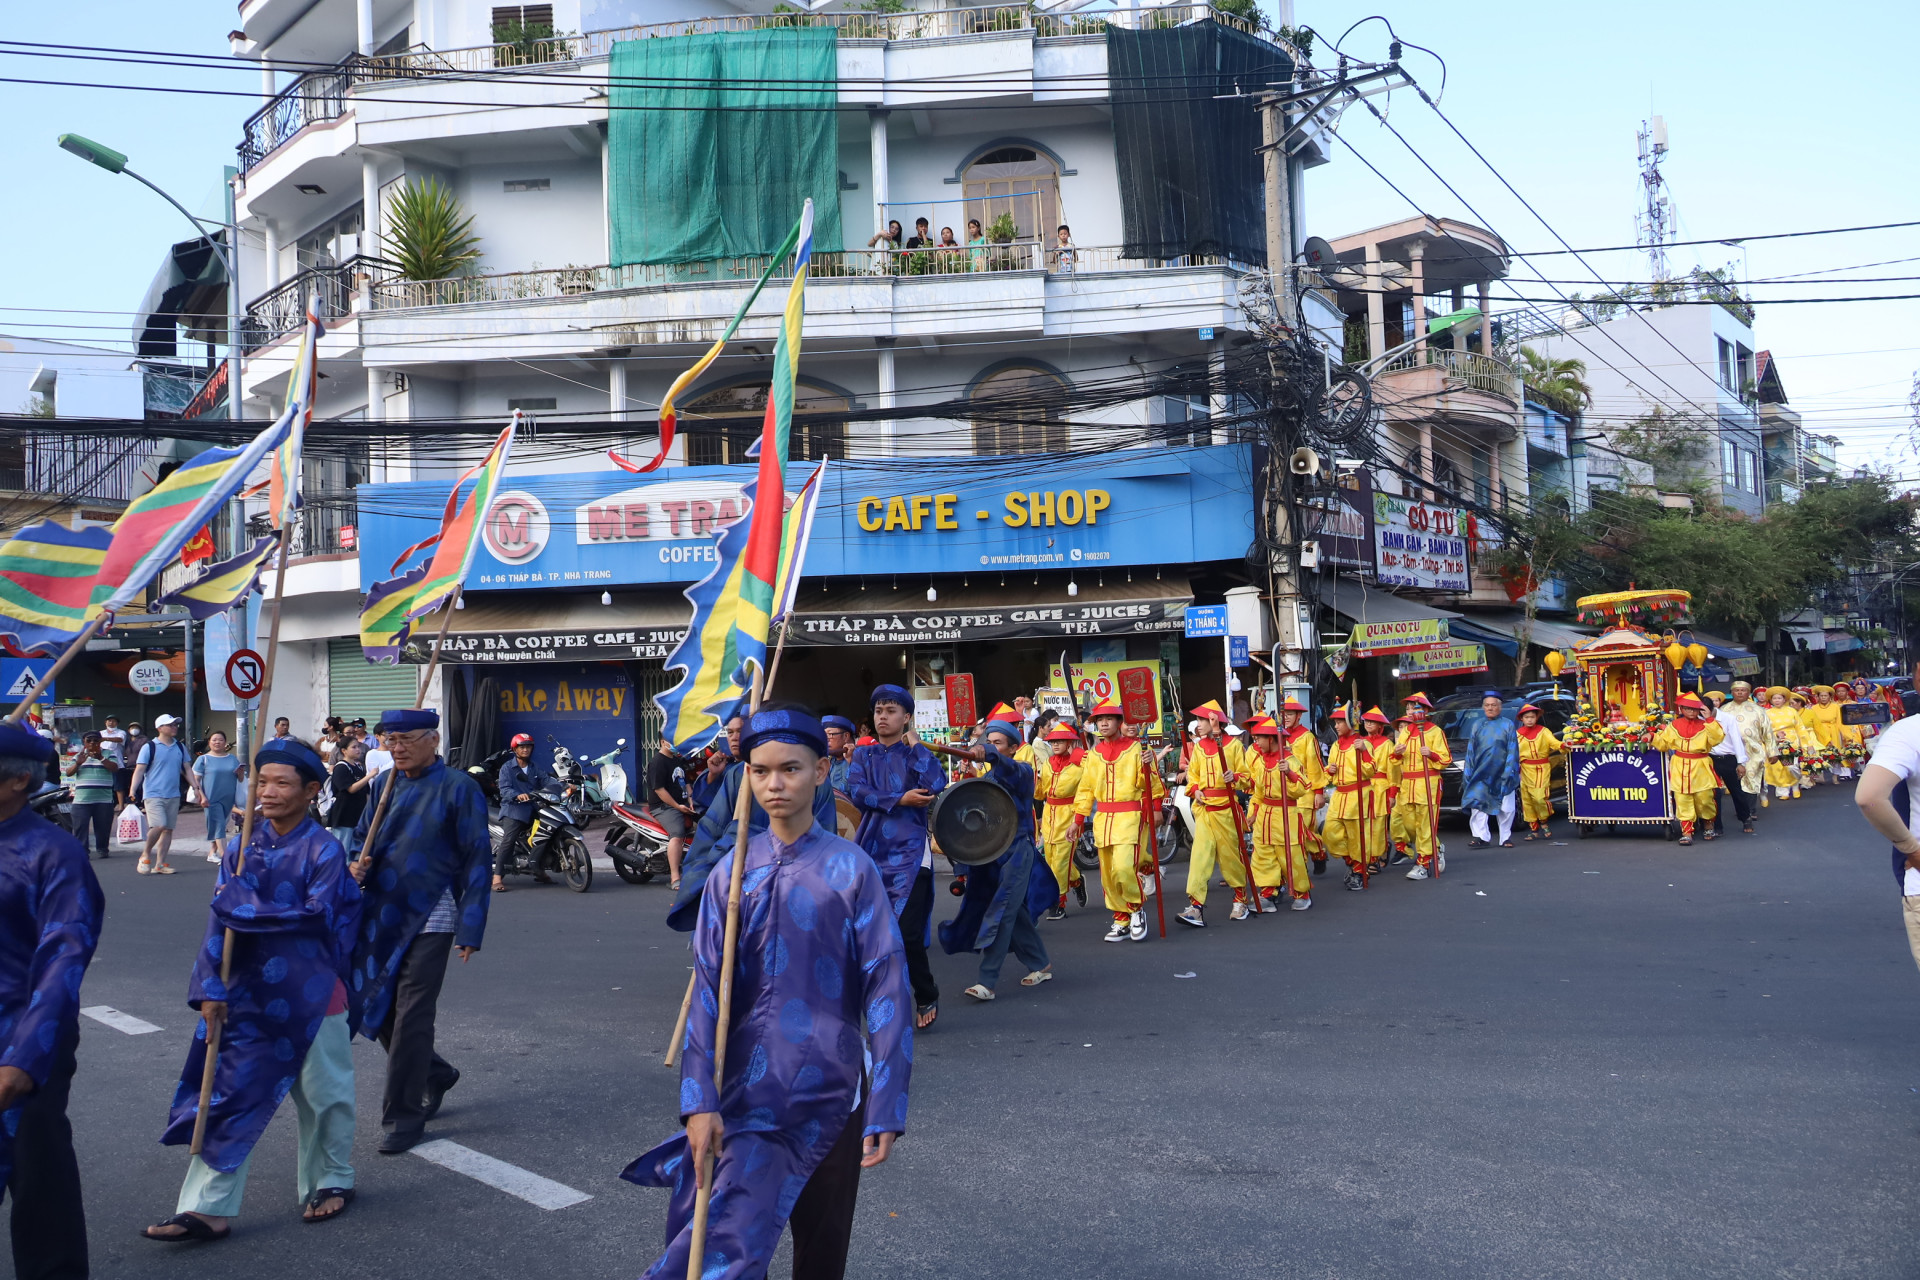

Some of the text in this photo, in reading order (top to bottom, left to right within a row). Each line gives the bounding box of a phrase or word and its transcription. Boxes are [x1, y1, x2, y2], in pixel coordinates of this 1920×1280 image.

[856, 493, 959, 532] CAFE
[1002, 489, 1111, 528] SHOP
[1409, 501, 1429, 531] CÔ
[587, 503, 649, 540] ME
[480, 575, 506, 584] 04-06
[564, 572, 581, 580] NHA
[584, 570, 612, 579] TRANG
[1010, 609, 1063, 622] CAFE
[1081, 604, 1150, 619] JUICES
[1188, 615, 1225, 628] 2 THÁNG 4
[804, 613, 1003, 632] THÁP BÀ COFFEE
[1061, 622, 1101, 634] TEA
[427, 634, 588, 651] THÁP BÀ COFFEE
[593, 631, 636, 644] CAFE
[649, 630, 688, 643] JUIC
[845, 628, 962, 642] Cà Phê Nguyên Chất
[461, 648, 556, 661] Cà Phê Nguyên Chất
[632, 645, 668, 657] TEA
[1053, 668, 1083, 677] QÁN
[498, 681, 626, 717] ake Away
[1576, 761, 1596, 786] ĐÌNH
[1641, 765, 1659, 785] LAO
[1589, 785, 1648, 803] VĨNH THỌ
